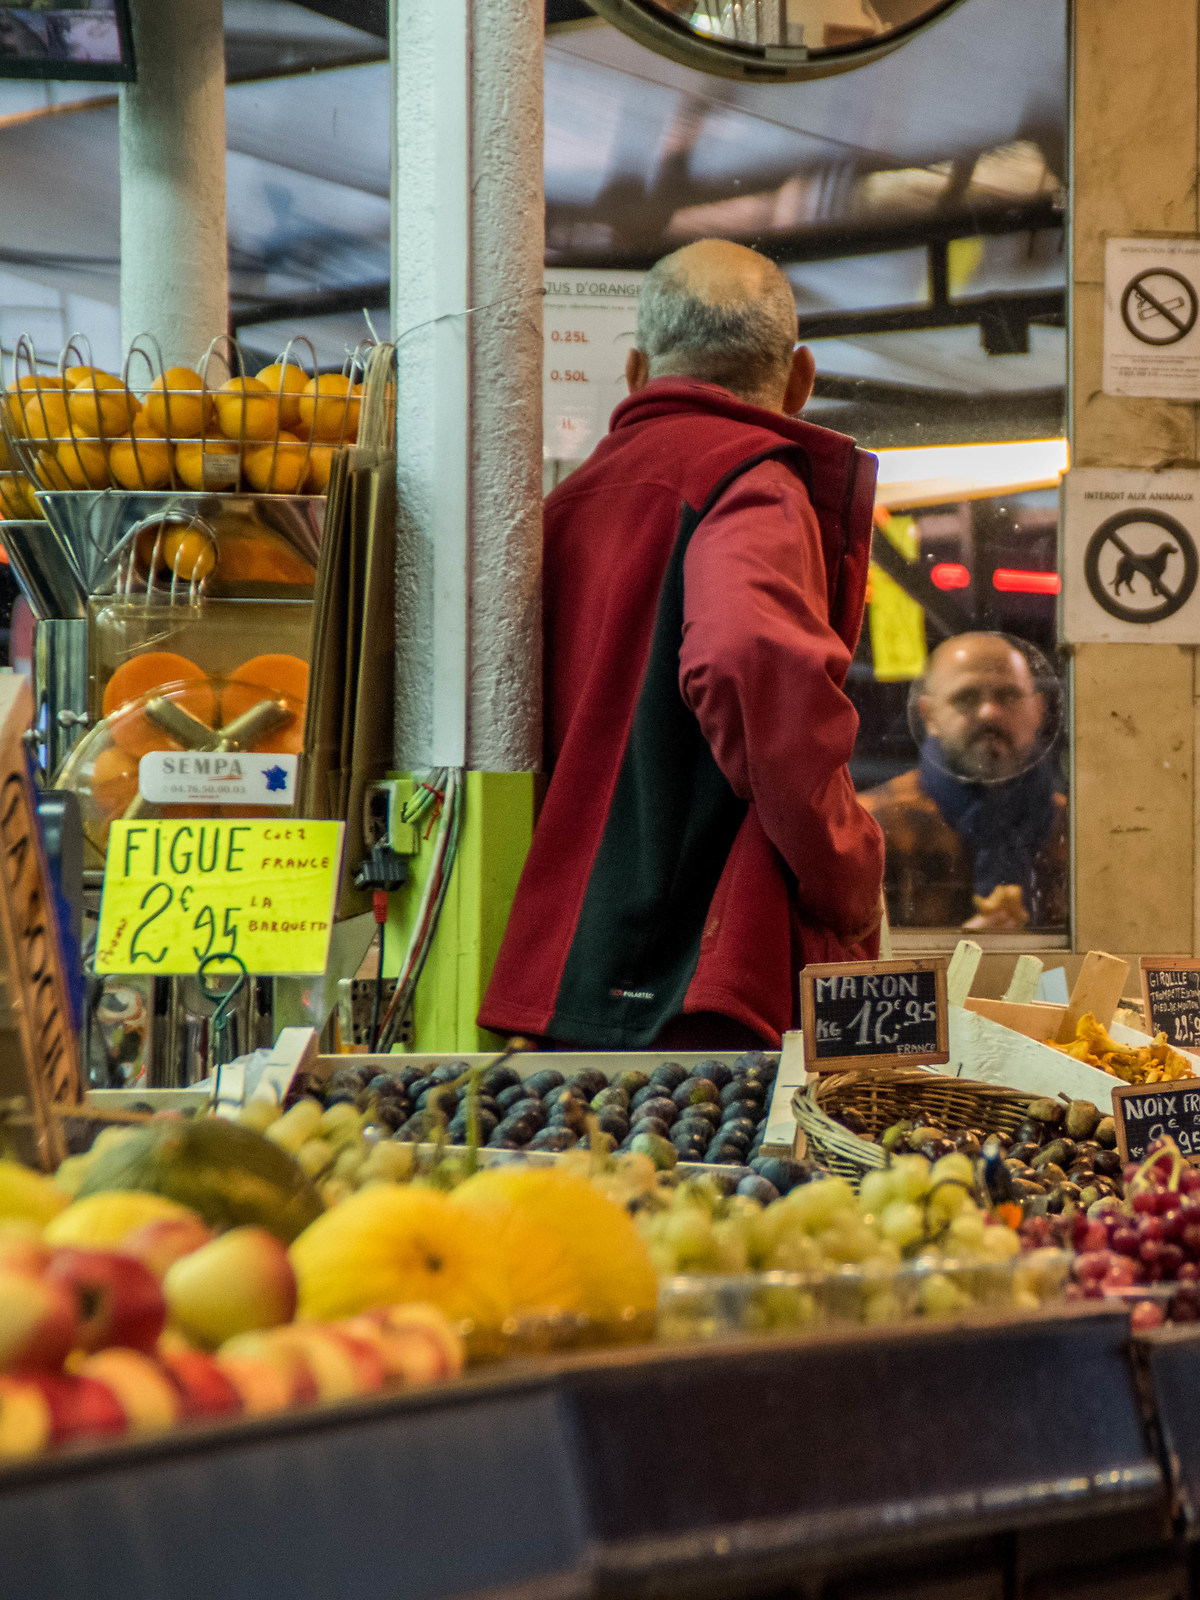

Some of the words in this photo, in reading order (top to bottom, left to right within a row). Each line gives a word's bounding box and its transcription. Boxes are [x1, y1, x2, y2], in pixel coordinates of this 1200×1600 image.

[545, 281, 570, 293] JUS
[551, 331, 590, 343] 0.25L
[551, 370, 590, 382] 0.50L
[1084, 491, 1125, 500] INTERDIT
[1127, 492, 1146, 500] AUX
[1149, 492, 1194, 501] ANIMAUX
[162, 757, 243, 775] SEMPA
[123, 820, 252, 877] FIGUE
[261, 857, 329, 869] FRANCE
[816, 975, 918, 1002] MARON
[896, 1043, 937, 1054] FRANCE
[1124, 1094, 1177, 1120] NOIX
